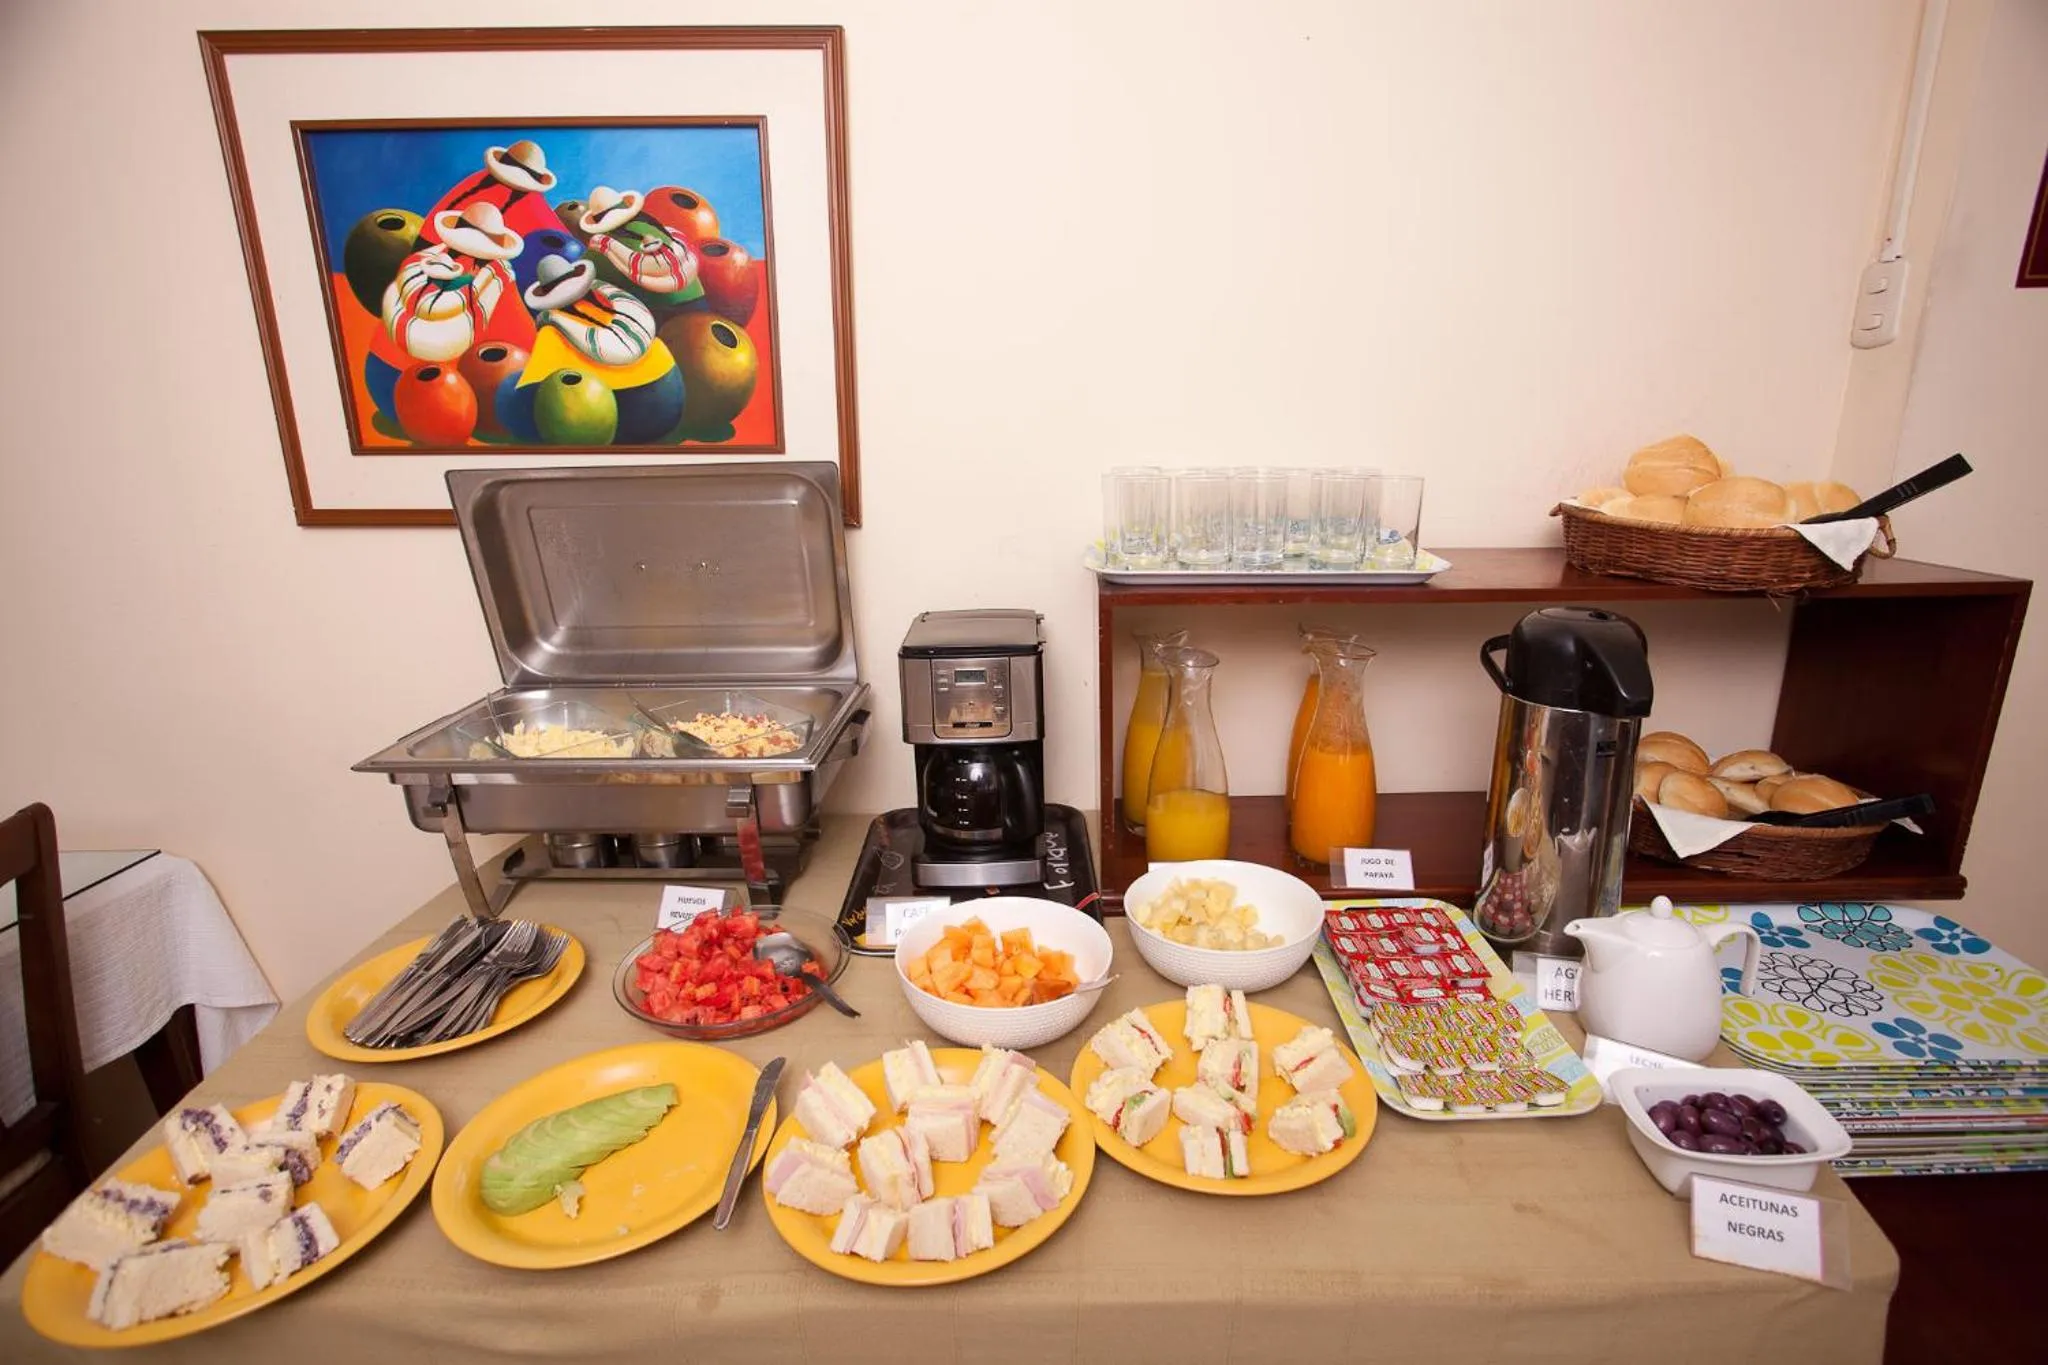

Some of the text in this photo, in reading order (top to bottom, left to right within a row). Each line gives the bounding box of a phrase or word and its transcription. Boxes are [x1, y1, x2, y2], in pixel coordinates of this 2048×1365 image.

[1364, 871, 1395, 879] PAPAYA
[677, 897, 706, 905] HUEVOS
[1629, 1053, 1664, 1068] LECHE
[1719, 1192, 1799, 1218] ACEITUNAS
[1727, 1220, 1786, 1243] NEGRAS
